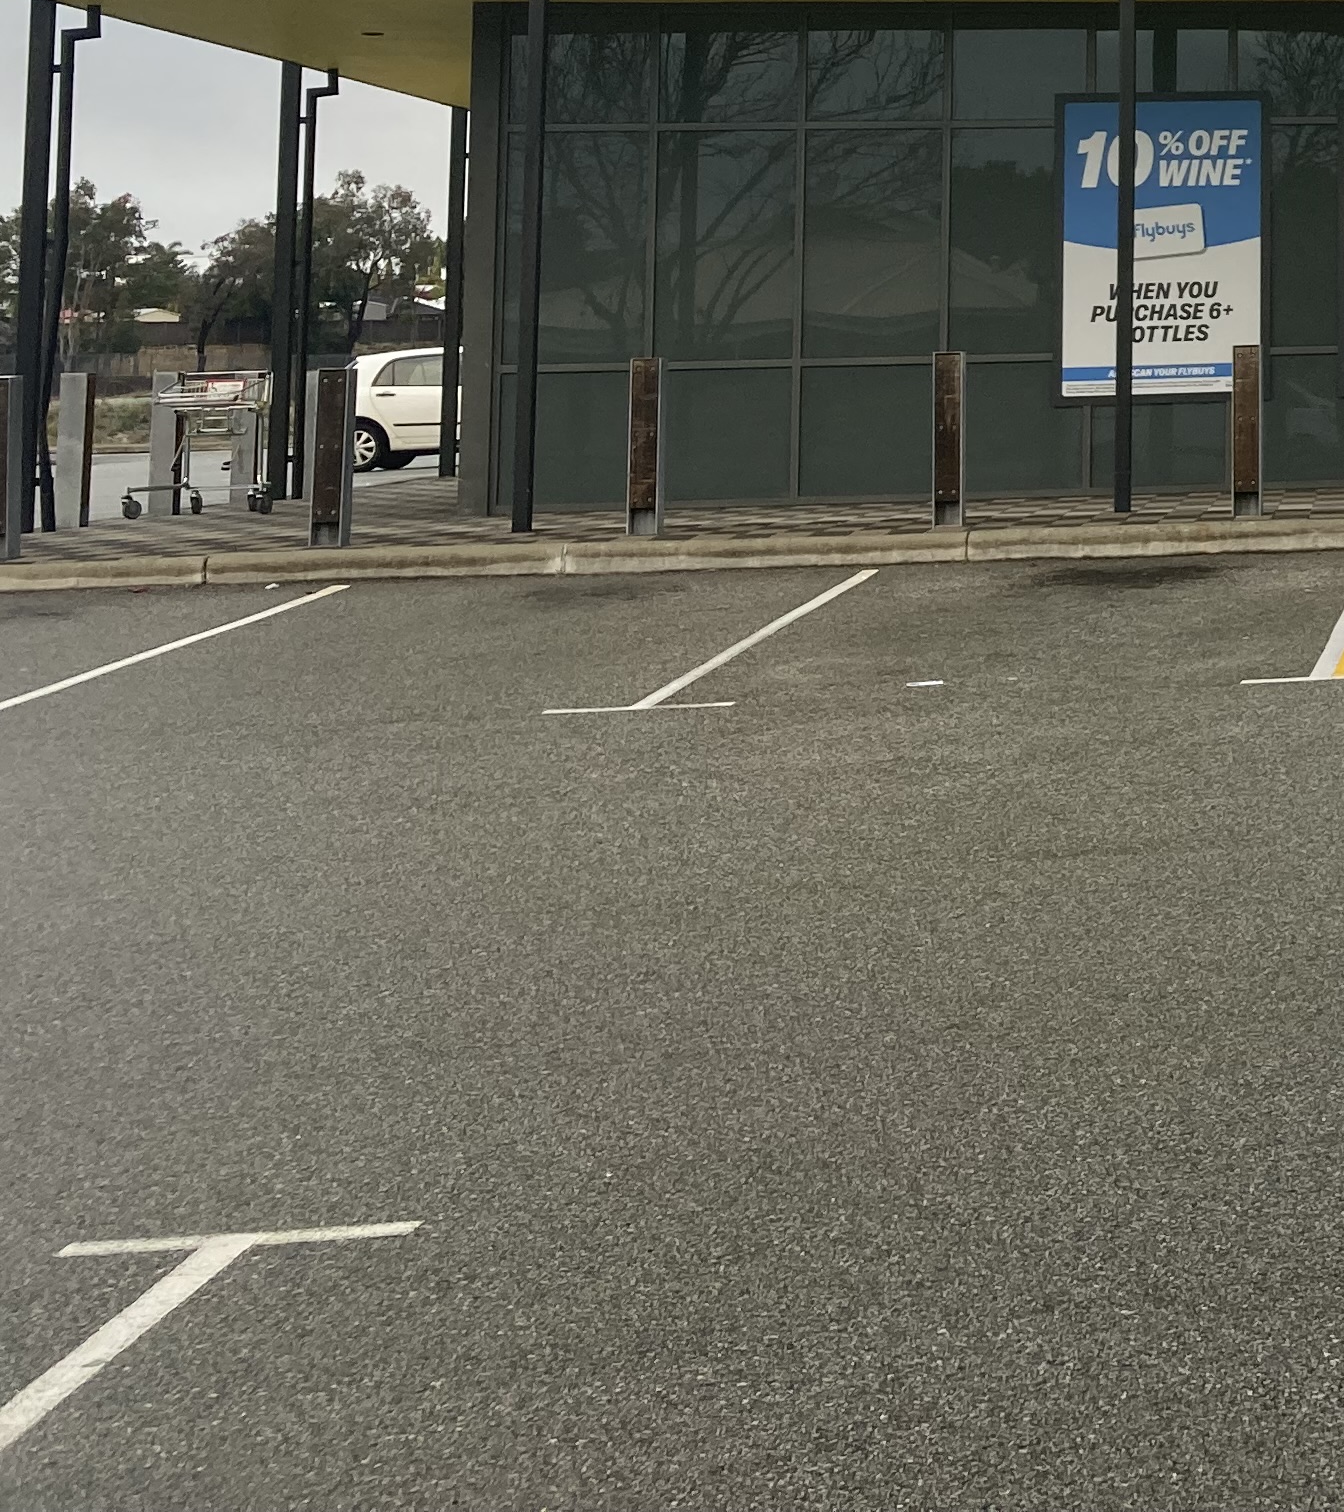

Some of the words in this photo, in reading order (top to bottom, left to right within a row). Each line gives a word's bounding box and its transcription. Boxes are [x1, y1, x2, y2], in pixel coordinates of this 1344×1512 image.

[1188, 129, 1249, 156] OFF
[1176, 281, 1219, 299] YOU
[1090, 303, 1205, 323] PUCHASE
[1208, 302, 1234, 320] 6+
[1178, 366, 1215, 376] FLYBUYS
